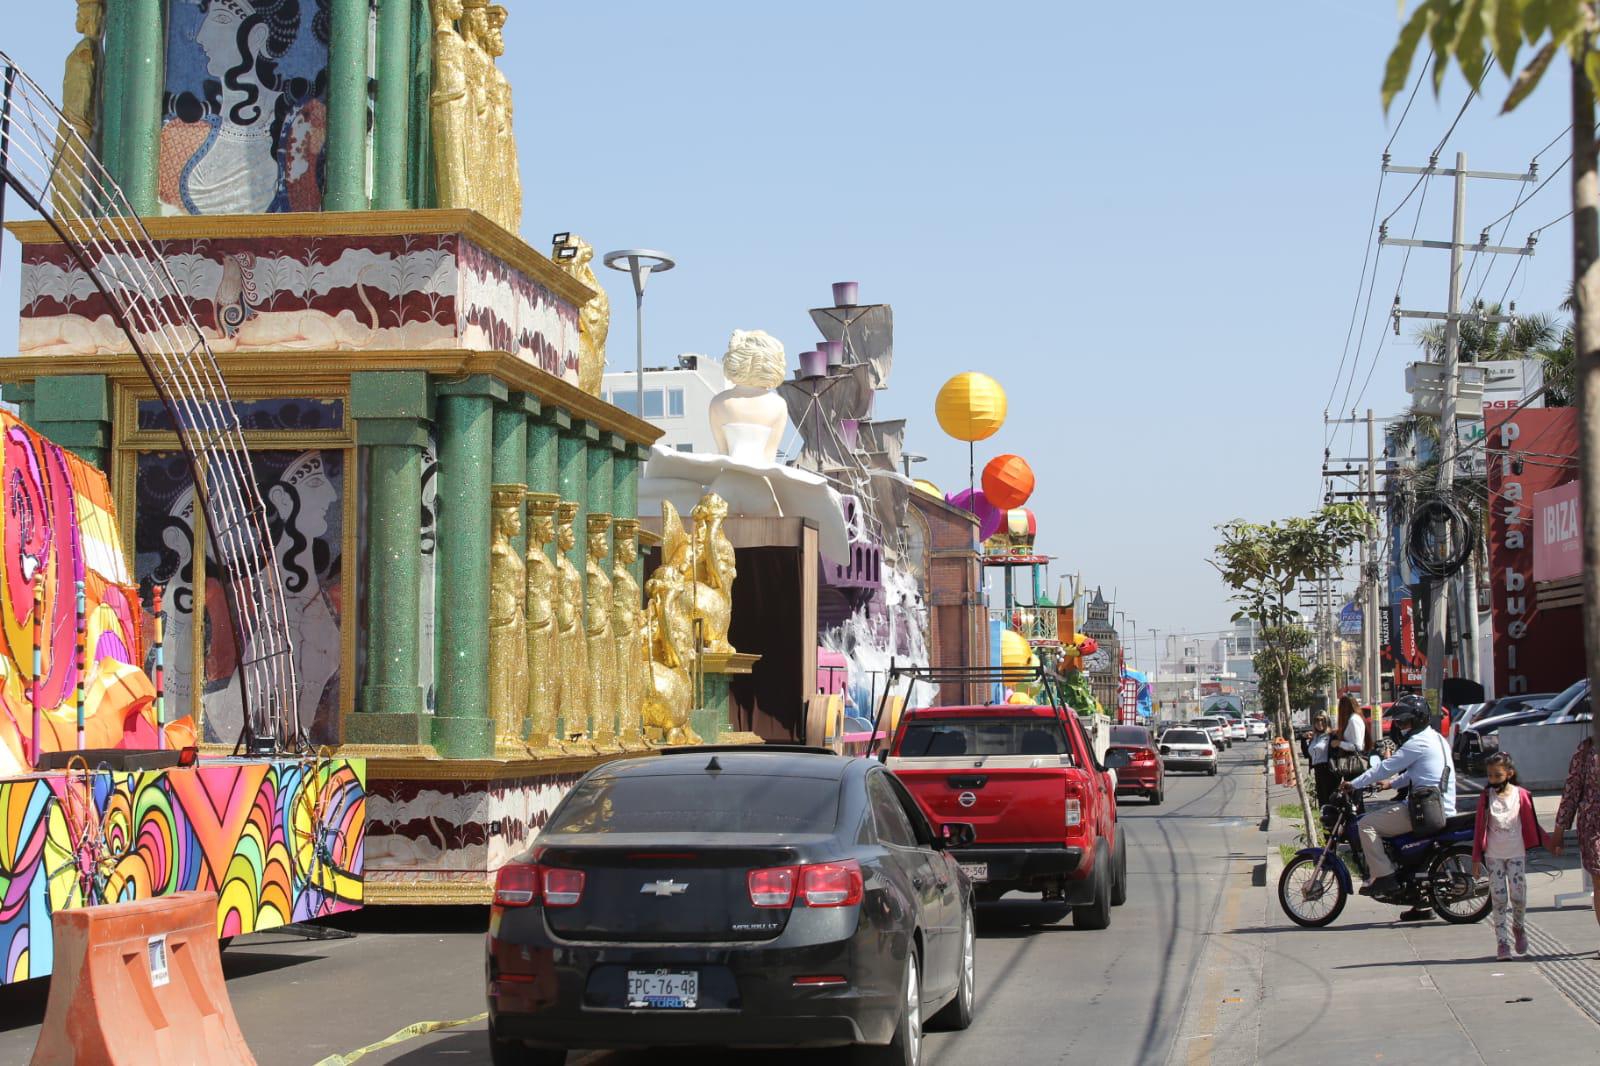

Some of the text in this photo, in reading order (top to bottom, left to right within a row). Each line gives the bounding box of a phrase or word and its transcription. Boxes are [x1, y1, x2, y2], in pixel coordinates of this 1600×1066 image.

[1483, 400, 1519, 409] DGE
[1464, 425, 1485, 441] Je
[1543, 499, 1578, 545] IBIZA
[1501, 422, 1528, 694] plaza bueln
